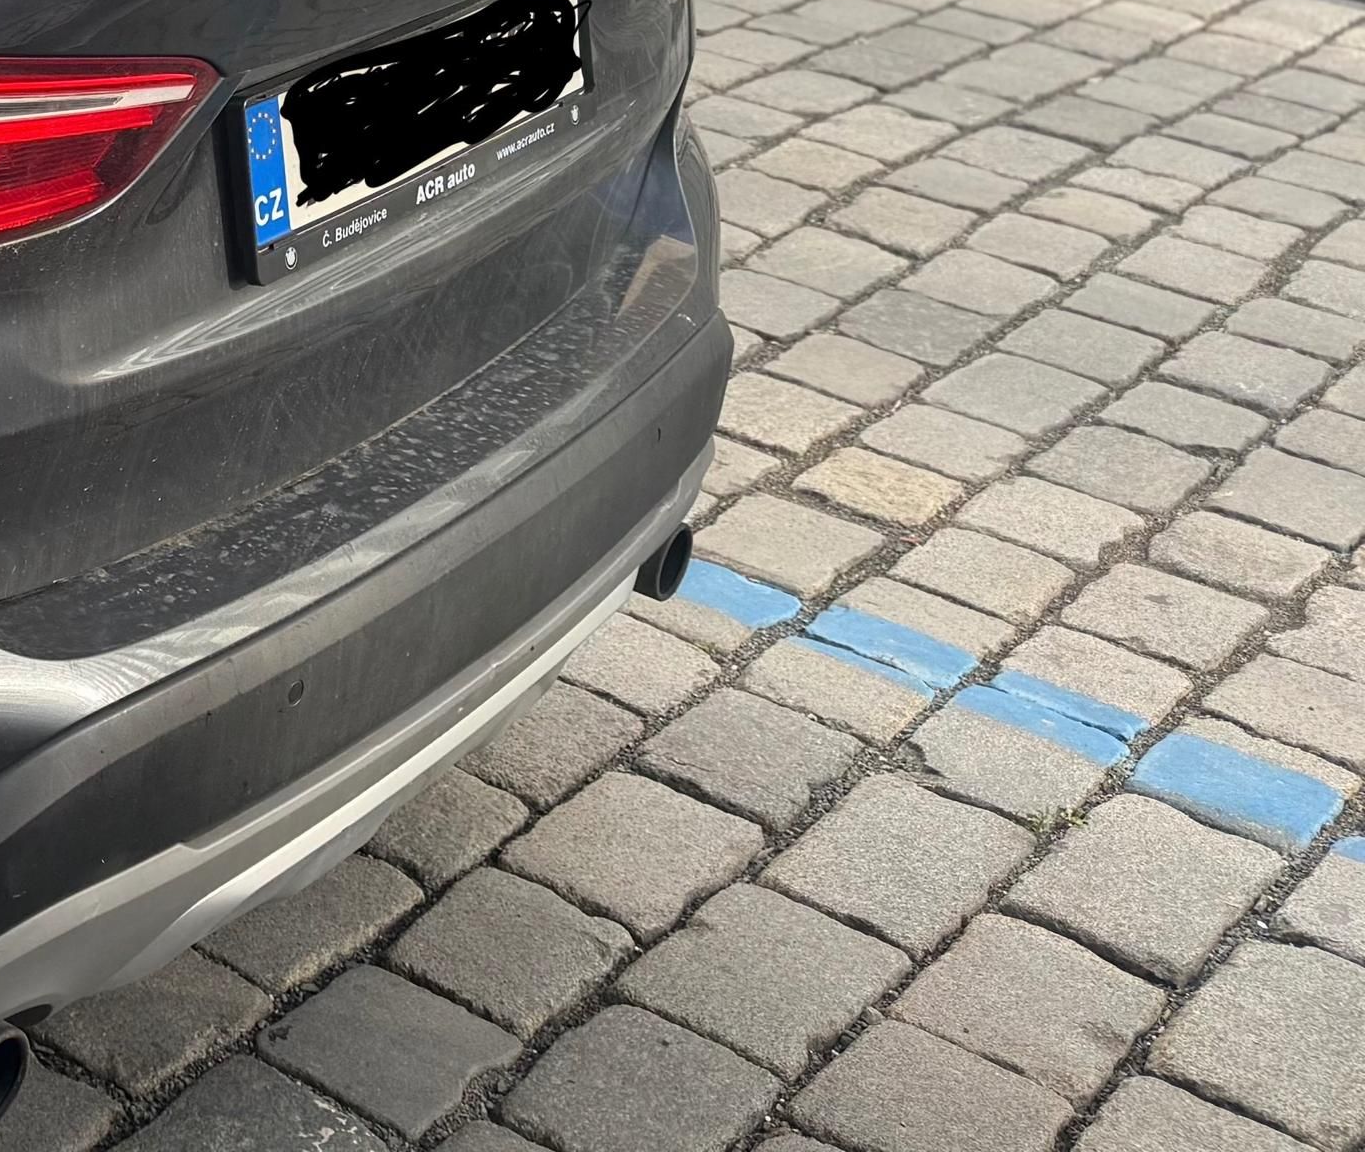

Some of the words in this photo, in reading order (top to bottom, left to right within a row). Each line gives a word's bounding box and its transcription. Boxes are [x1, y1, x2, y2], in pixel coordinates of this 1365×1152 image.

[495, 122, 556, 161] www.acrauto.cz
[415, 179, 445, 205] ACR
[447, 163, 477, 189] auto
[254, 188, 285, 227] CZ
[335, 208, 388, 243] Budějovice
